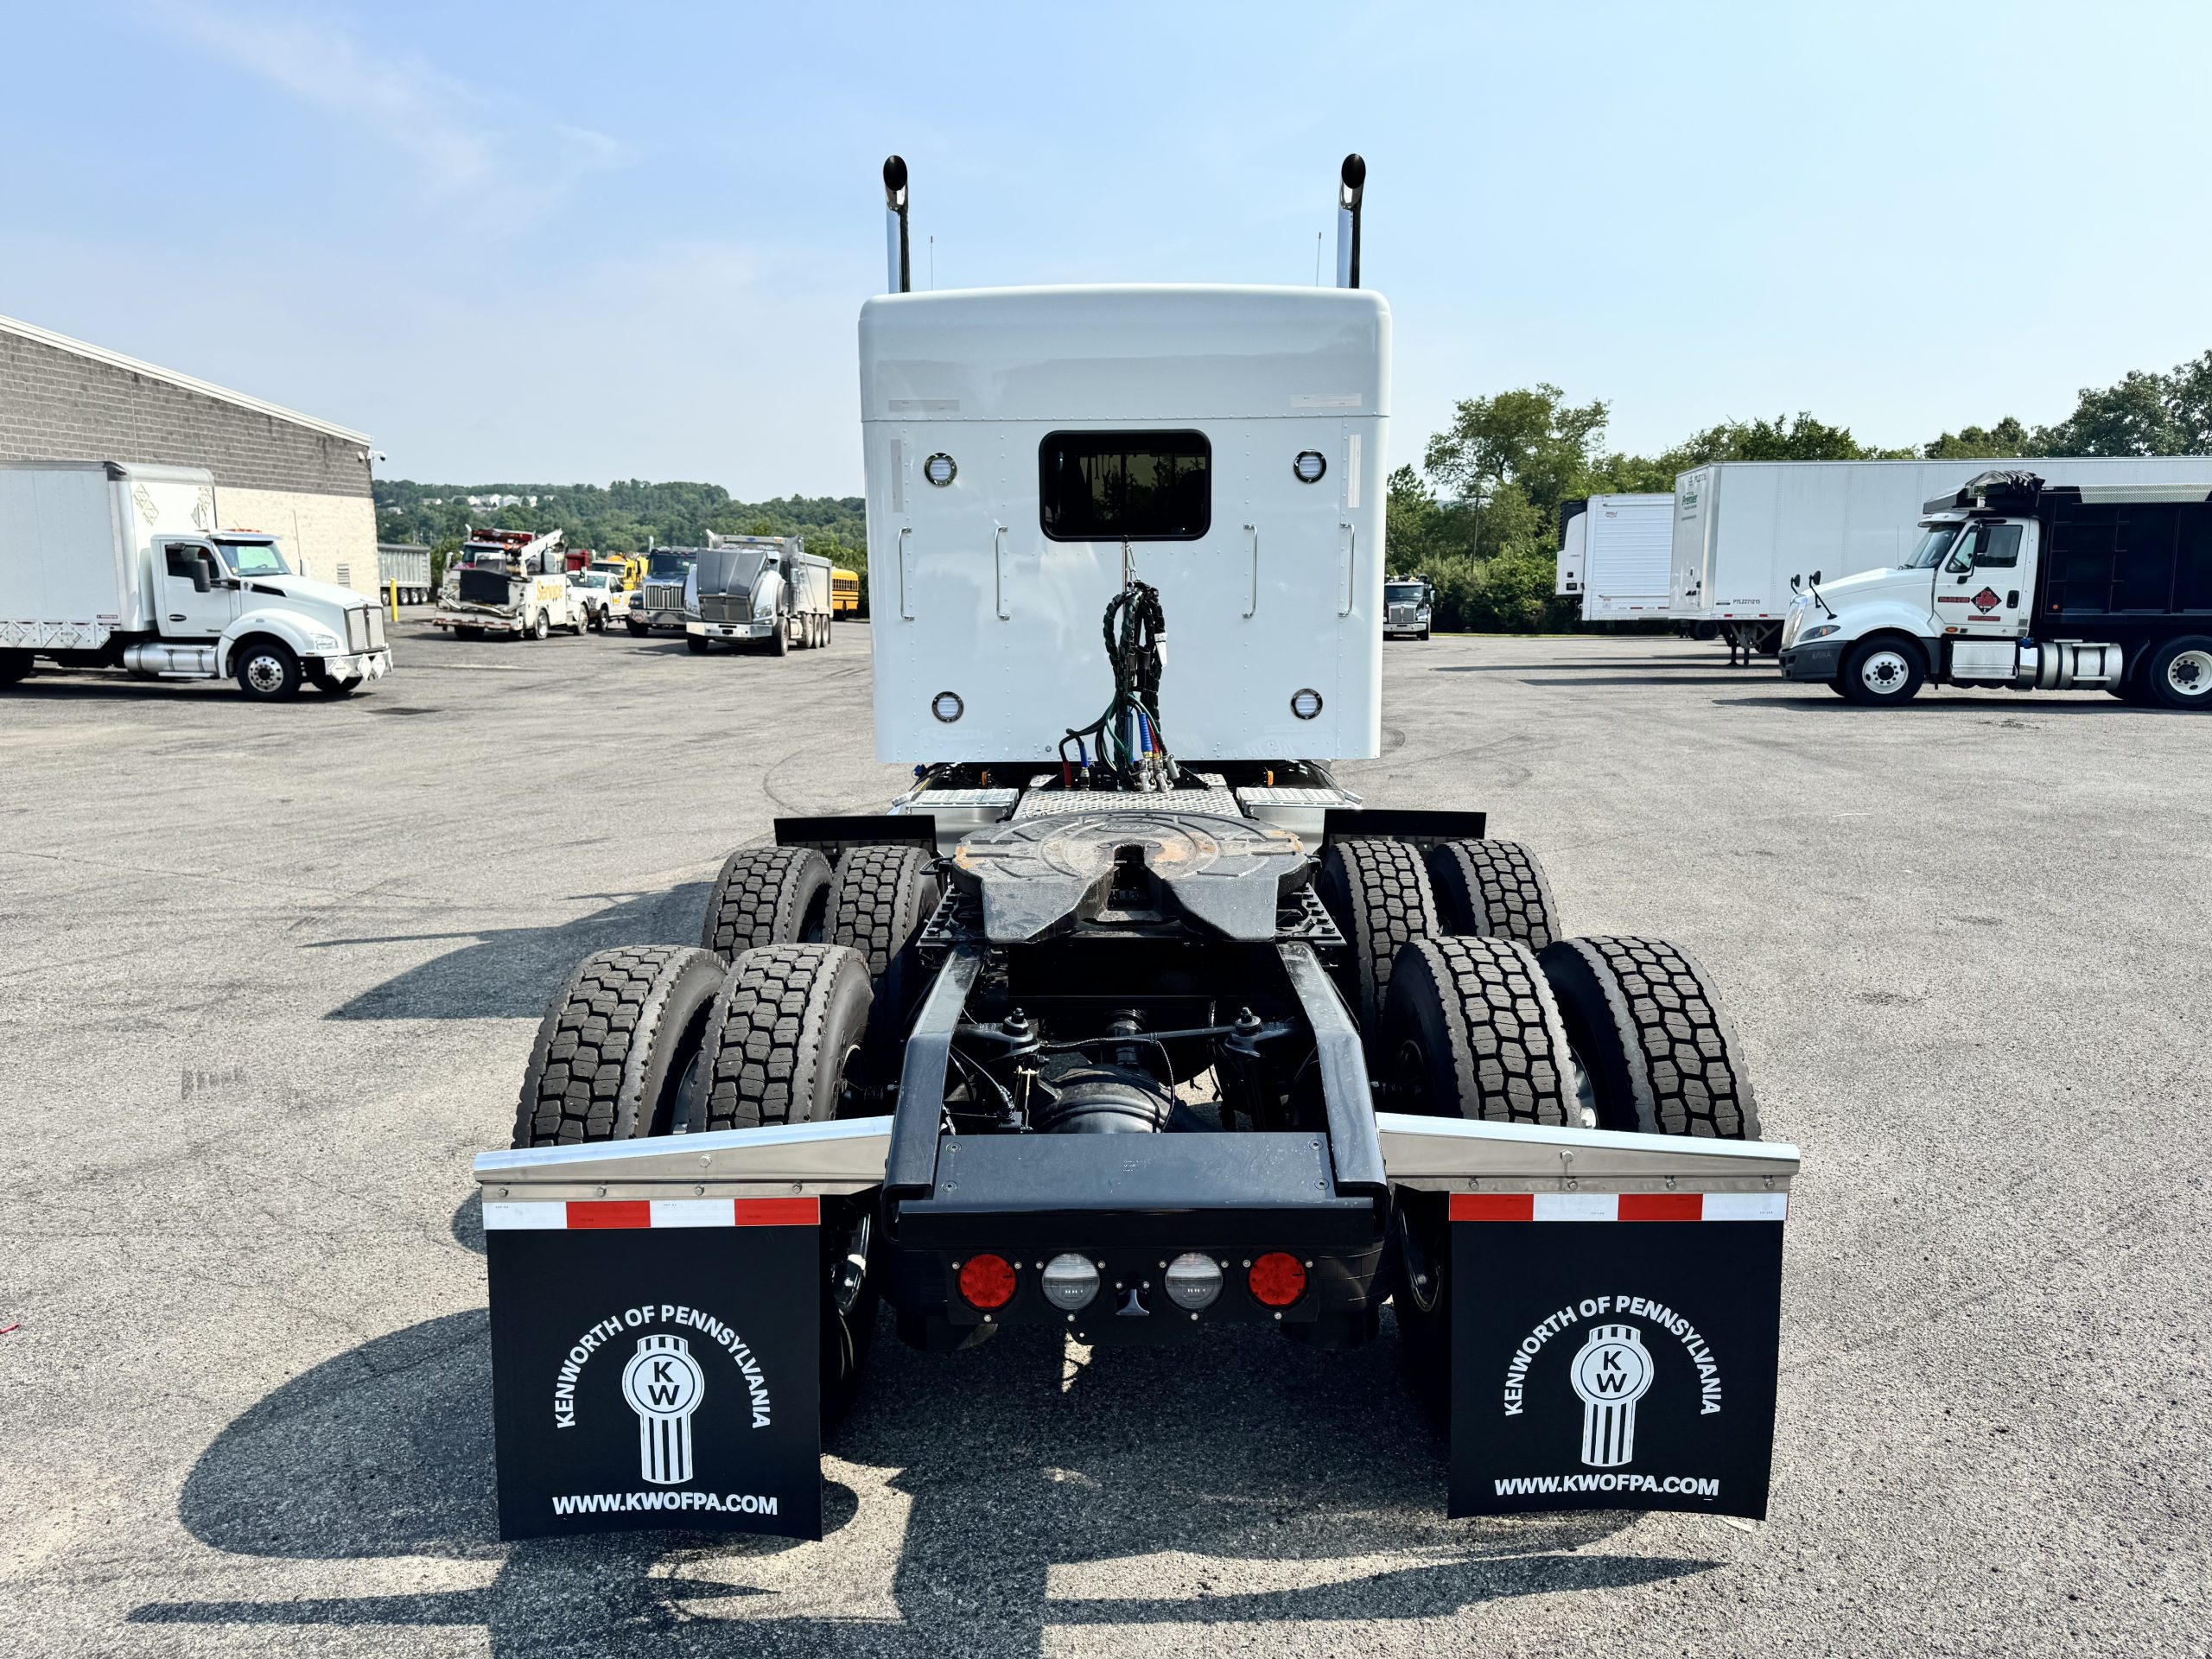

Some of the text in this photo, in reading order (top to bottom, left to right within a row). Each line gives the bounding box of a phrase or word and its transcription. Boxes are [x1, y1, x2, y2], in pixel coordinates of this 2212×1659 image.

[537, 581, 563, 601] Service
[555, 1305, 771, 1428] KENWORTH OF PENNSYLVANIA
[1504, 1295, 1722, 1416] KENWORTH OF PENNSYLVANIA
[1603, 1351, 1623, 1371] K
[653, 1362, 674, 1382] K
[1595, 1373, 1628, 1393] W
[648, 1384, 681, 1406] W
[1495, 1474, 1719, 1497] WWW.KWOFPA.COM
[552, 1492, 778, 1516] WWW.KWOFPA.COM
